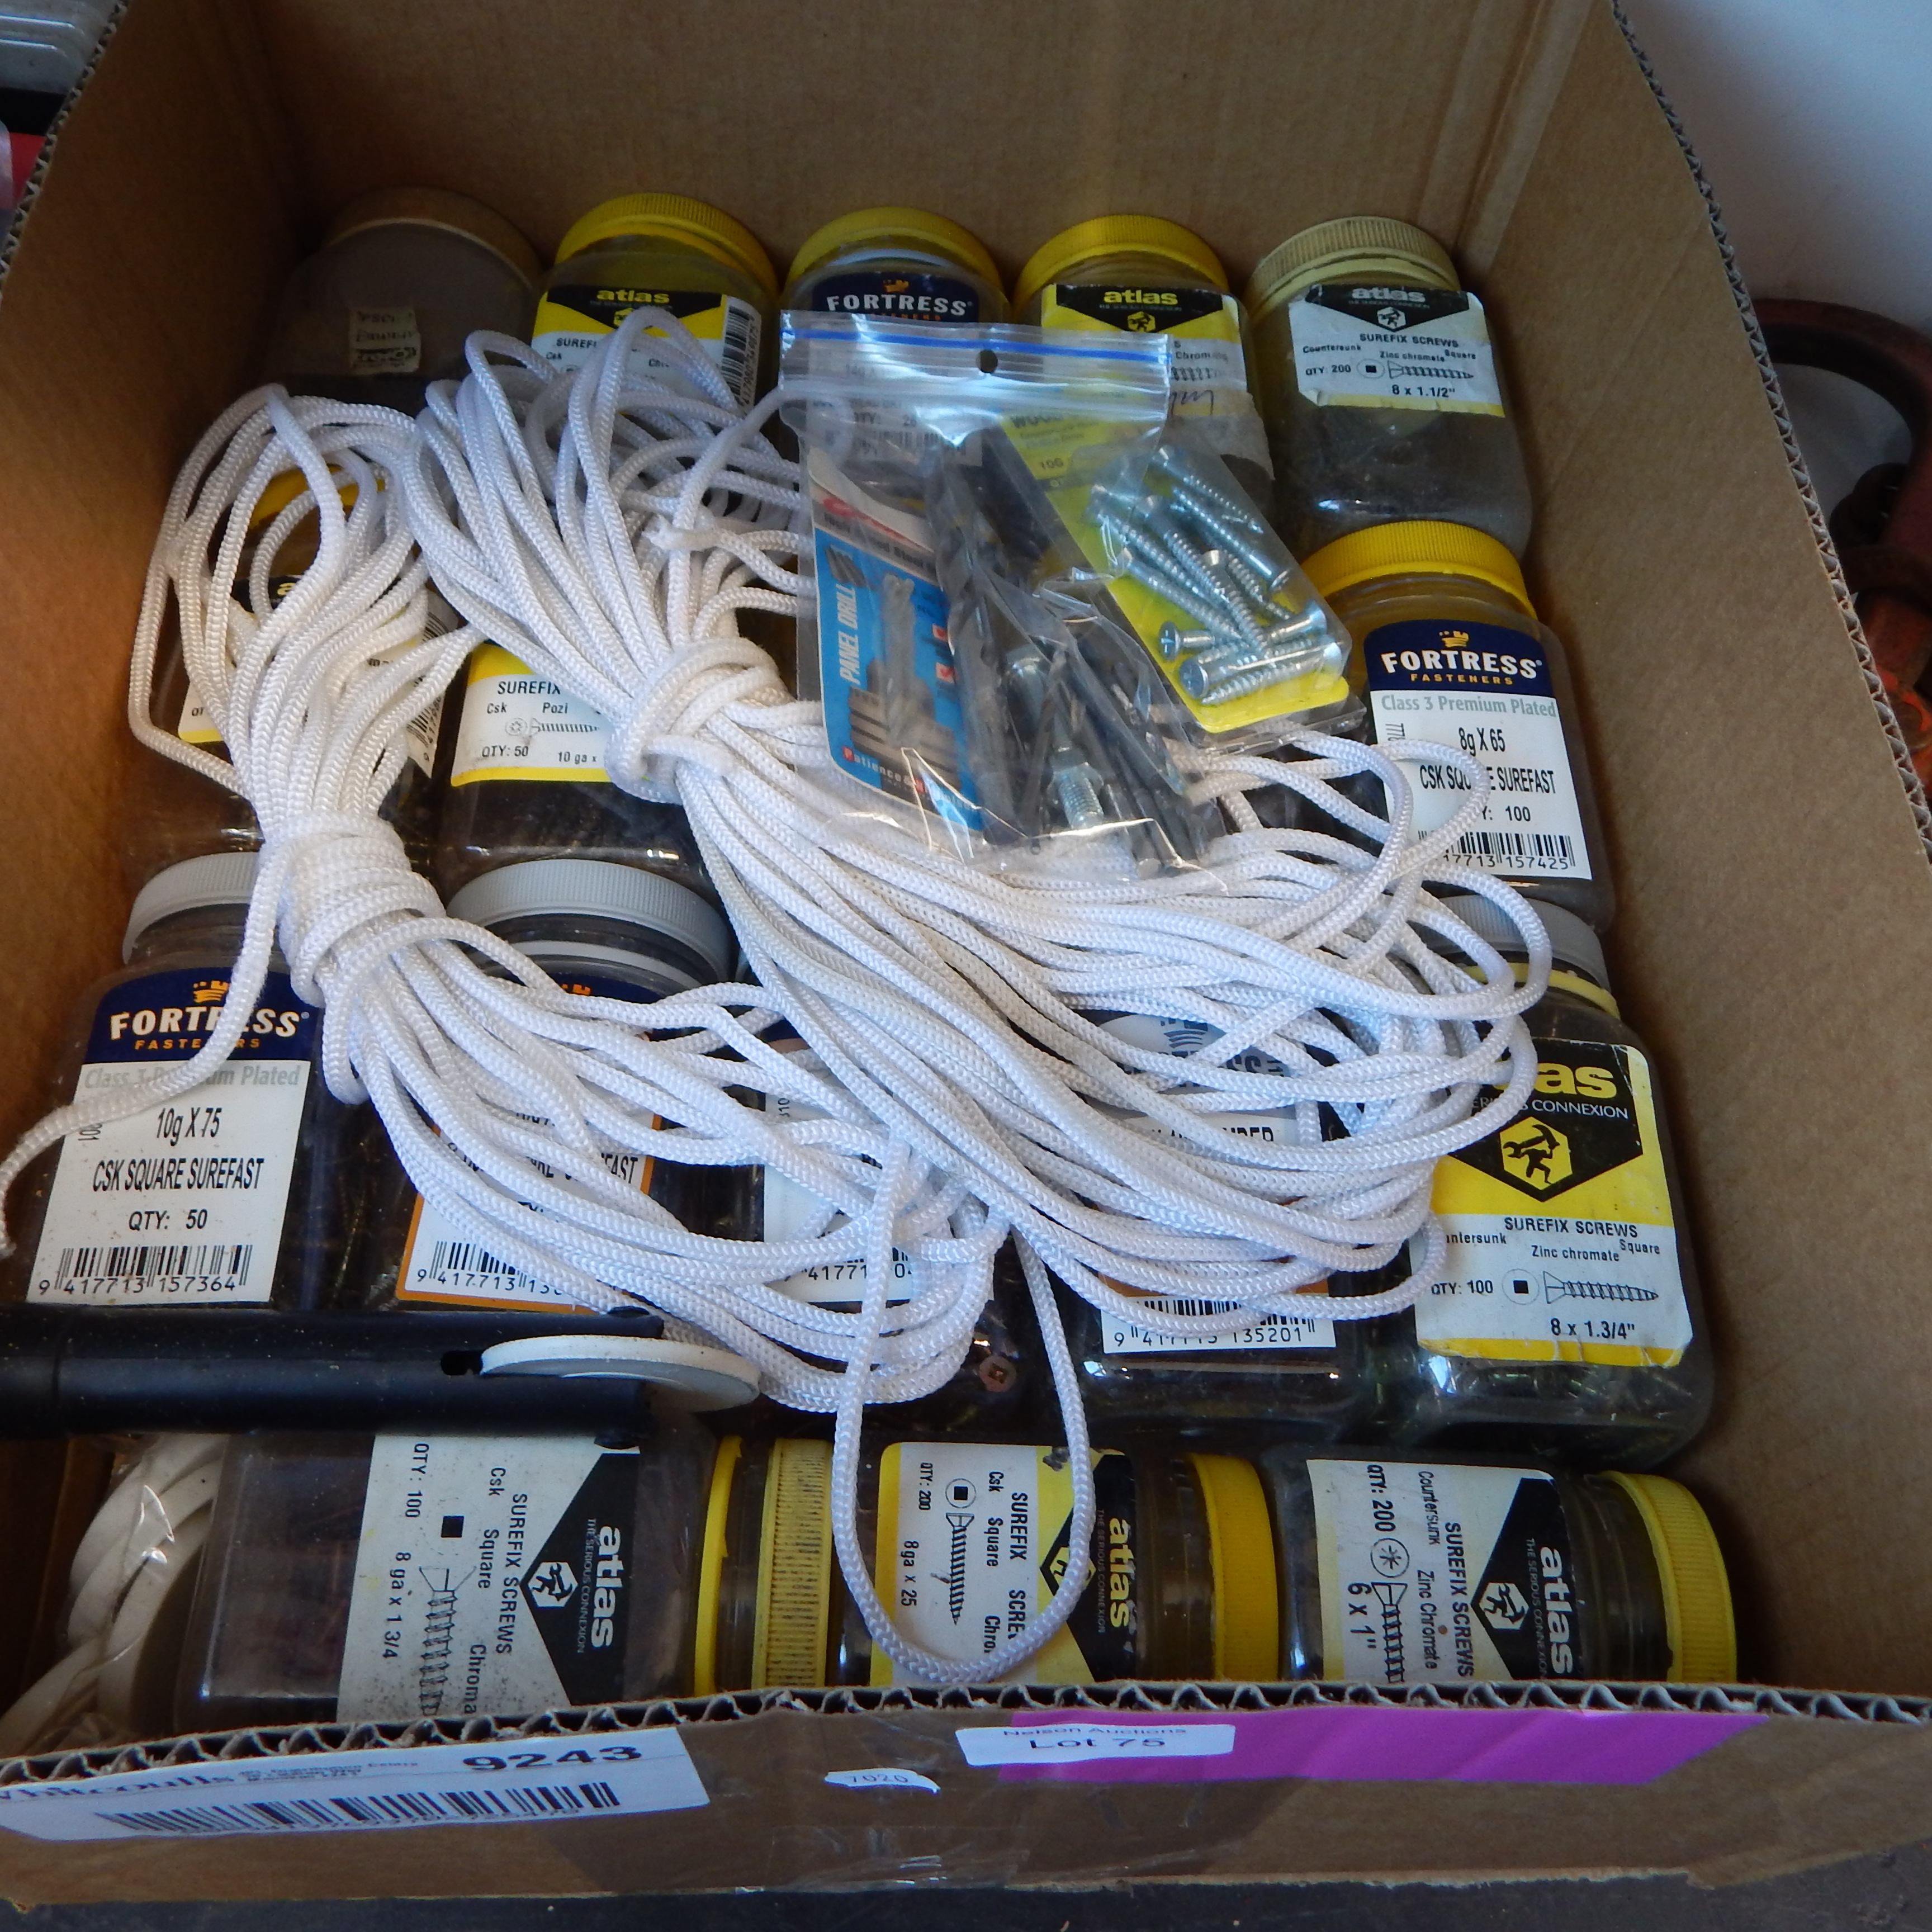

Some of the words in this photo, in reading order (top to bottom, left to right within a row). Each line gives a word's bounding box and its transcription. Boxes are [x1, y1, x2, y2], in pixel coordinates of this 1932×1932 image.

[596, 289, 670, 304] atlas
[826, 293, 967, 316] FORTRESS
[1104, 289, 1178, 306] atlas
[1352, 286, 1426, 304] atlas
[556, 337, 597, 348] SUREFI
[1360, 333, 1407, 344] SUREFIX
[1412, 336, 1459, 348] SCREWS
[1332, 364, 1352, 374] 200
[1391, 385, 1400, 395] 8
[1405, 387, 1412, 396] x
[836, 583, 859, 630] DRILL
[838, 630, 861, 686] PANEL
[1380, 649, 1538, 680] FORTRESS
[497, 681, 561, 695] SUREFIX
[1410, 673, 1513, 685] FASTENERS
[486, 702, 508, 714] Csk
[542, 702, 569, 714] Pozi
[1381, 695, 1420, 711] Class
[1425, 697, 1433, 711] 3
[1438, 695, 1507, 713] Premium
[1512, 697, 1557, 718] Plated
[481, 745, 511, 758] QTY:
[514, 745, 529, 757] 50
[1458, 727, 1476, 756] 8g
[1478, 726, 1489, 752] X
[1489, 728, 1505, 752] 65
[558, 751, 570, 763] 10
[574, 754, 588, 765] ga
[1419, 764, 1446, 789] CSK
[1497, 766, 1556, 794] SUREFAST
[1505, 805, 1531, 822] 100
[1505, 856, 1569, 870] 157425
[134, 1038, 261, 1050] FASTERS
[240, 1065, 300, 1086] Plated
[1532, 1099, 1628, 1119] CONNEXION
[157, 1107, 182, 1147] 10g
[185, 1107, 201, 1138] X
[200, 1107, 222, 1139] 75
[92, 1159, 126, 1192] CSK
[125, 1158, 187, 1191] SQUARE
[186, 1157, 265, 1190] SUREFAST
[128, 1210, 171, 1231] QTY:
[186, 1208, 208, 1229] 50
[1504, 1216, 1569, 1233] SUREFIX
[1576, 1221, 1639, 1238] SCREWS
[1532, 1245, 1558, 1259] Zinc
[1561, 1247, 1620, 1262] chromate
[1619, 1239, 1660, 1255] Square
[39, 1280, 50, 1295] 9
[63, 1277, 144, 1295] 417713
[159, 1277, 236, 1292] 157364
[417, 1268, 428, 1282] 9
[437, 1270, 516, 1291] 417713
[1431, 1282, 1462, 1295] QTY:
[1466, 1280, 1494, 1294] 100
[1550, 1318, 1561, 1336] 8
[1568, 1324, 1576, 1336] x
[1114, 1332, 1125, 1347] 9
[410, 1443, 430, 1481] QTY:
[488, 1467, 506, 1497] Csk
[919, 1462, 934, 1486] QTY:
[988, 1471, 1004, 1493] Csk
[1366, 1464, 1388, 1494] QTY:
[405, 1490, 423, 1518] 100
[918, 1489, 932, 1510] 200
[1418, 1470, 1441, 1545] Countersunk
[1010, 1493, 1029, 1560] SUREFIX
[1372, 1500, 1396, 1532] 200
[505, 1494, 528, 1568] SUREFIX
[983, 1517, 1003, 1567] Square
[395, 1552, 411, 1562] 8
[477, 1528, 499, 1589] Square
[901, 1541, 919, 1567] 8ga
[1097, 1529, 1106, 1572] SERIOUS
[1445, 1522, 1467, 1597] SUREFIX
[1526, 1538, 1537, 1558] THE
[582, 1538, 595, 1585] SERIOUS
[1109, 1517, 1136, 1628] atlas
[390, 1569, 405, 1590] ga
[591, 1526, 625, 1649] atlas
[904, 1575, 916, 1583] x
[1348, 1583, 1372, 1596] 6
[1417, 1569, 1435, 1598] Zinc
[1528, 1559, 1541, 1606] SERIOUS
[389, 1597, 401, 1606] x
[901, 1589, 917, 1607] 25
[1096, 1574, 1106, 1633] CONNEXION
[495, 1578, 519, 1654] SCREWS
[576, 1585, 591, 1654] CONNEXION
[1007, 1589, 1026, 1640] SCRE
[1348, 1604, 1368, 1616] x
[1540, 1546, 1573, 1674] atlas
[382, 1631, 401, 1659] 3/4
[984, 1615, 1001, 1654] Chro
[1420, 1603, 1438, 1670] Chromate
[1452, 1602, 1475, 1677] SCREWS
[1029, 1737, 1096, 1749] Lot
[1111, 1737, 1166, 1748] 75
[462, 1746, 642, 1770] 9243
[850, 1774, 909, 1783] 7020
